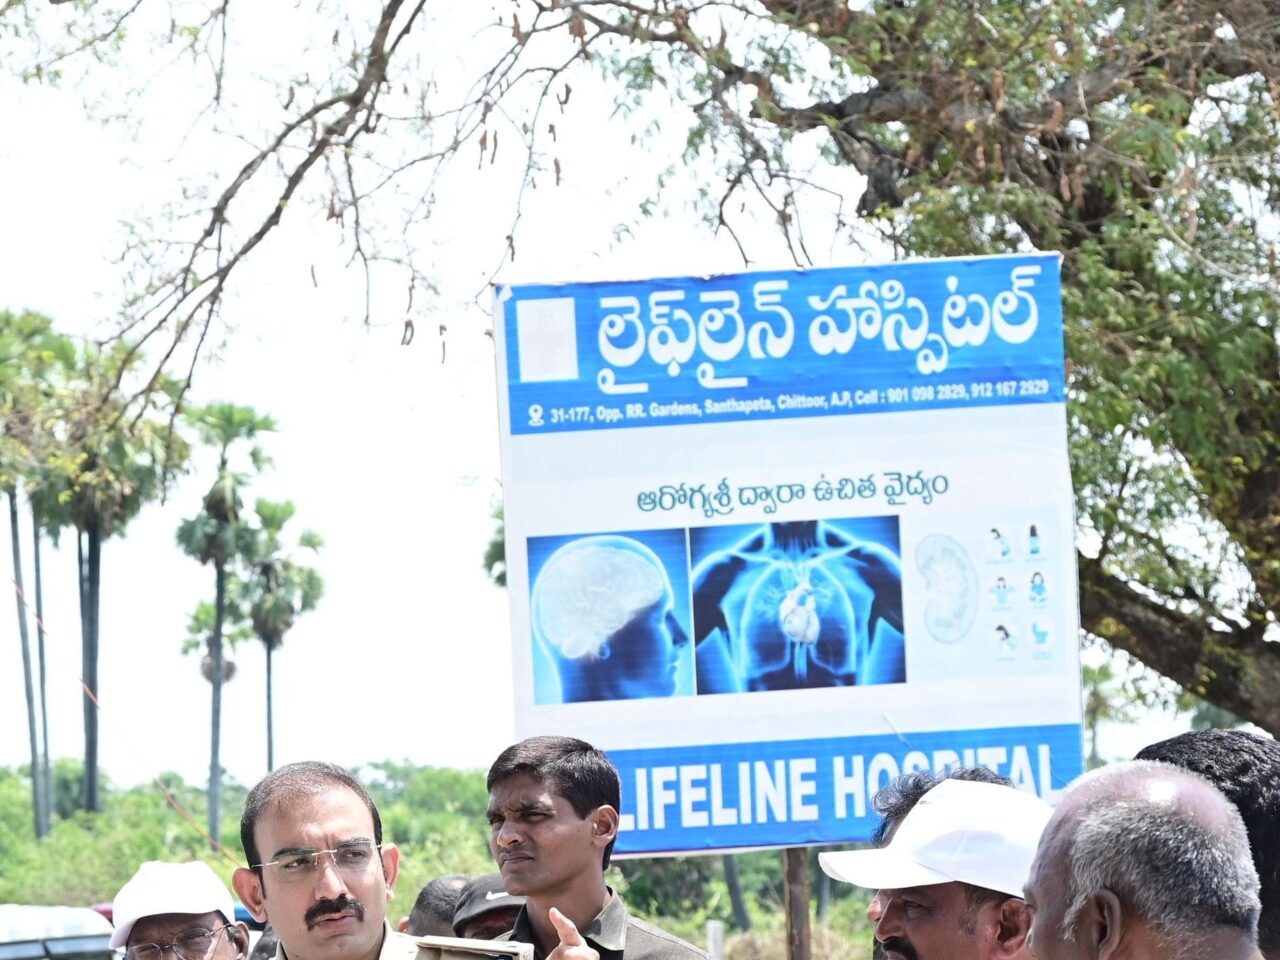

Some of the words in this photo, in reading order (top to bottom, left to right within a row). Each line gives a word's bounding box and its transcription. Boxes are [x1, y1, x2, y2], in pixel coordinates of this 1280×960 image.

[807, 265, 1041, 376] హాస్పిటల్
[551, 406, 593, 424] 31-177,
[596, 405, 623, 422] Opp.
[626, 403, 646, 418] RR.
[649, 401, 702, 418] Gardens,
[705, 397, 775, 414] Santhapeta,
[778, 394, 828, 410] Chittoor,
[855, 389, 878, 404] Cell
[887, 388, 908, 403] 901
[971, 382, 993, 398] 912
[996, 381, 1017, 396] 167
[738, 484, 806, 514] ద్వారా
[813, 474, 877, 502] ఉచిత
[883, 471, 950, 505] వైద్యం
